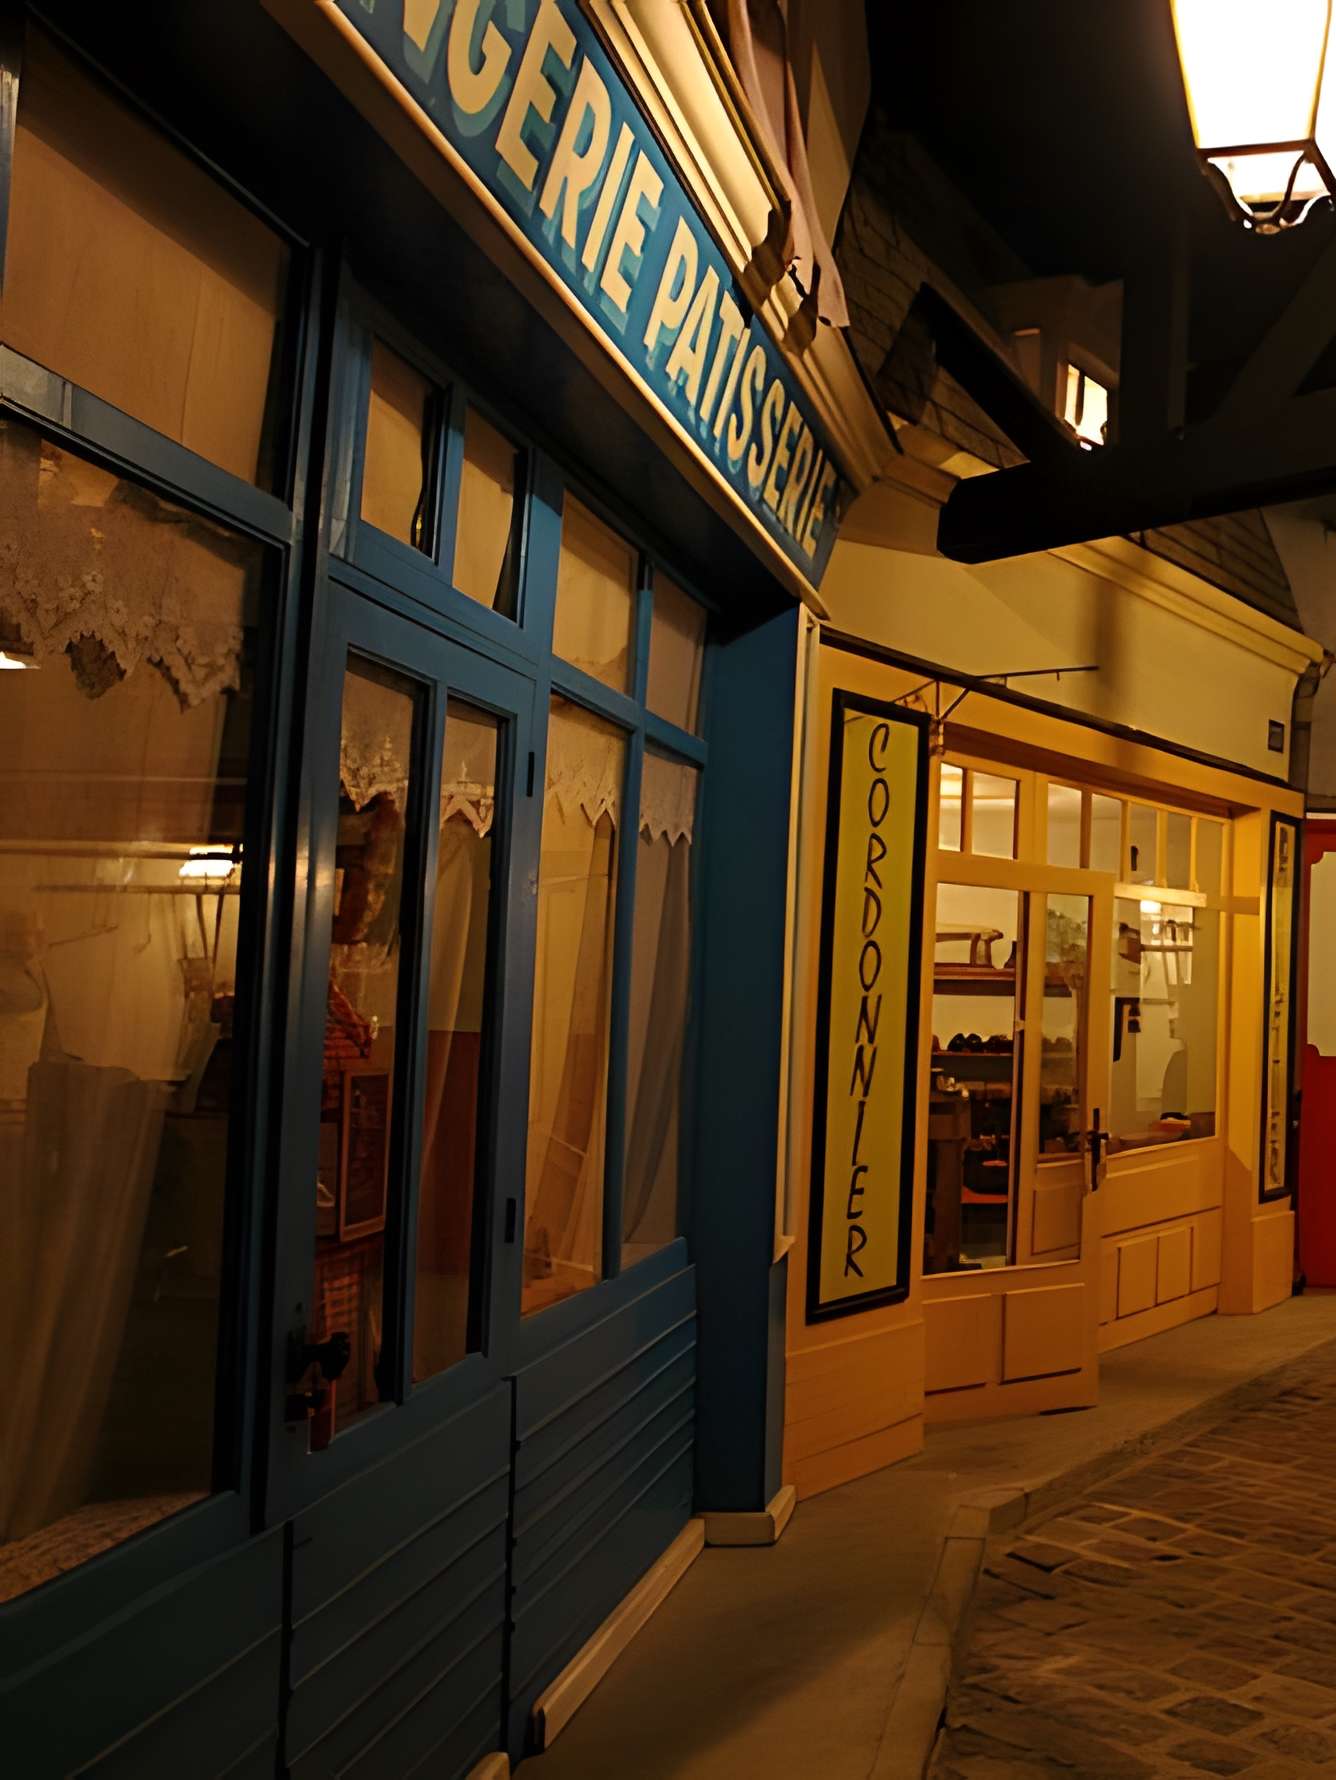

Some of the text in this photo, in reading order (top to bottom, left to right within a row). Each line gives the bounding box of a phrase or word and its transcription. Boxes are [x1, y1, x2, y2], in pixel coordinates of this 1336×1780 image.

[403, 0, 838, 561] GERIE PATISSERIE
[843, 722, 890, 1278] CORDONNIER
